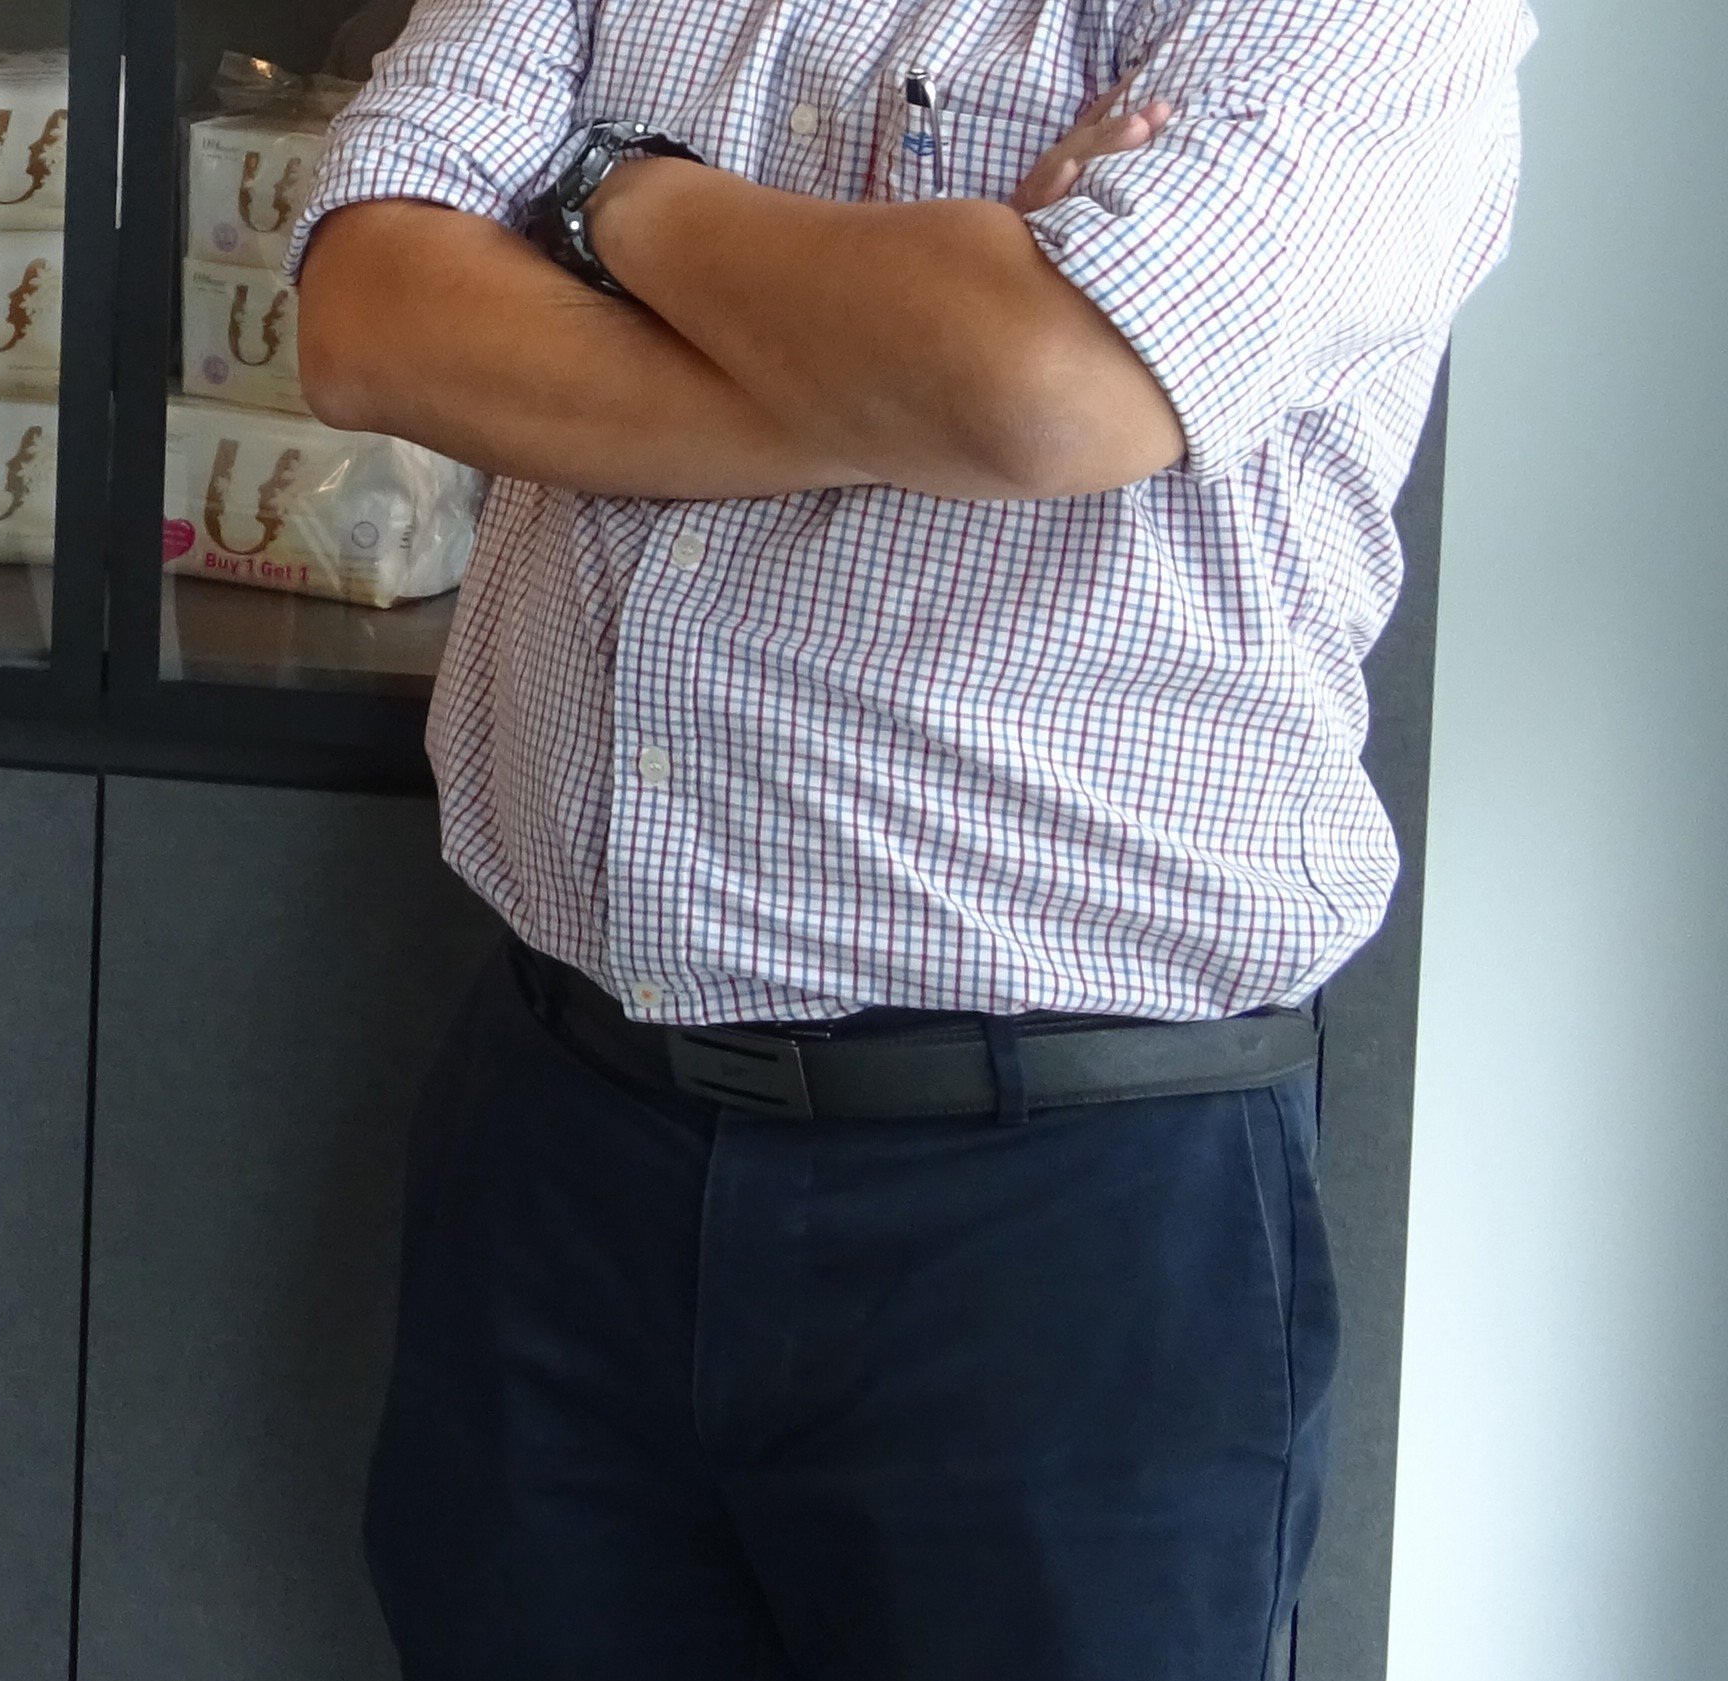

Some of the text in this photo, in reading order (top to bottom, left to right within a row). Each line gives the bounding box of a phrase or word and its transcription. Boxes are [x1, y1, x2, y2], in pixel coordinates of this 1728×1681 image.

[205, 552, 310, 581] Buy 1 Get 1
